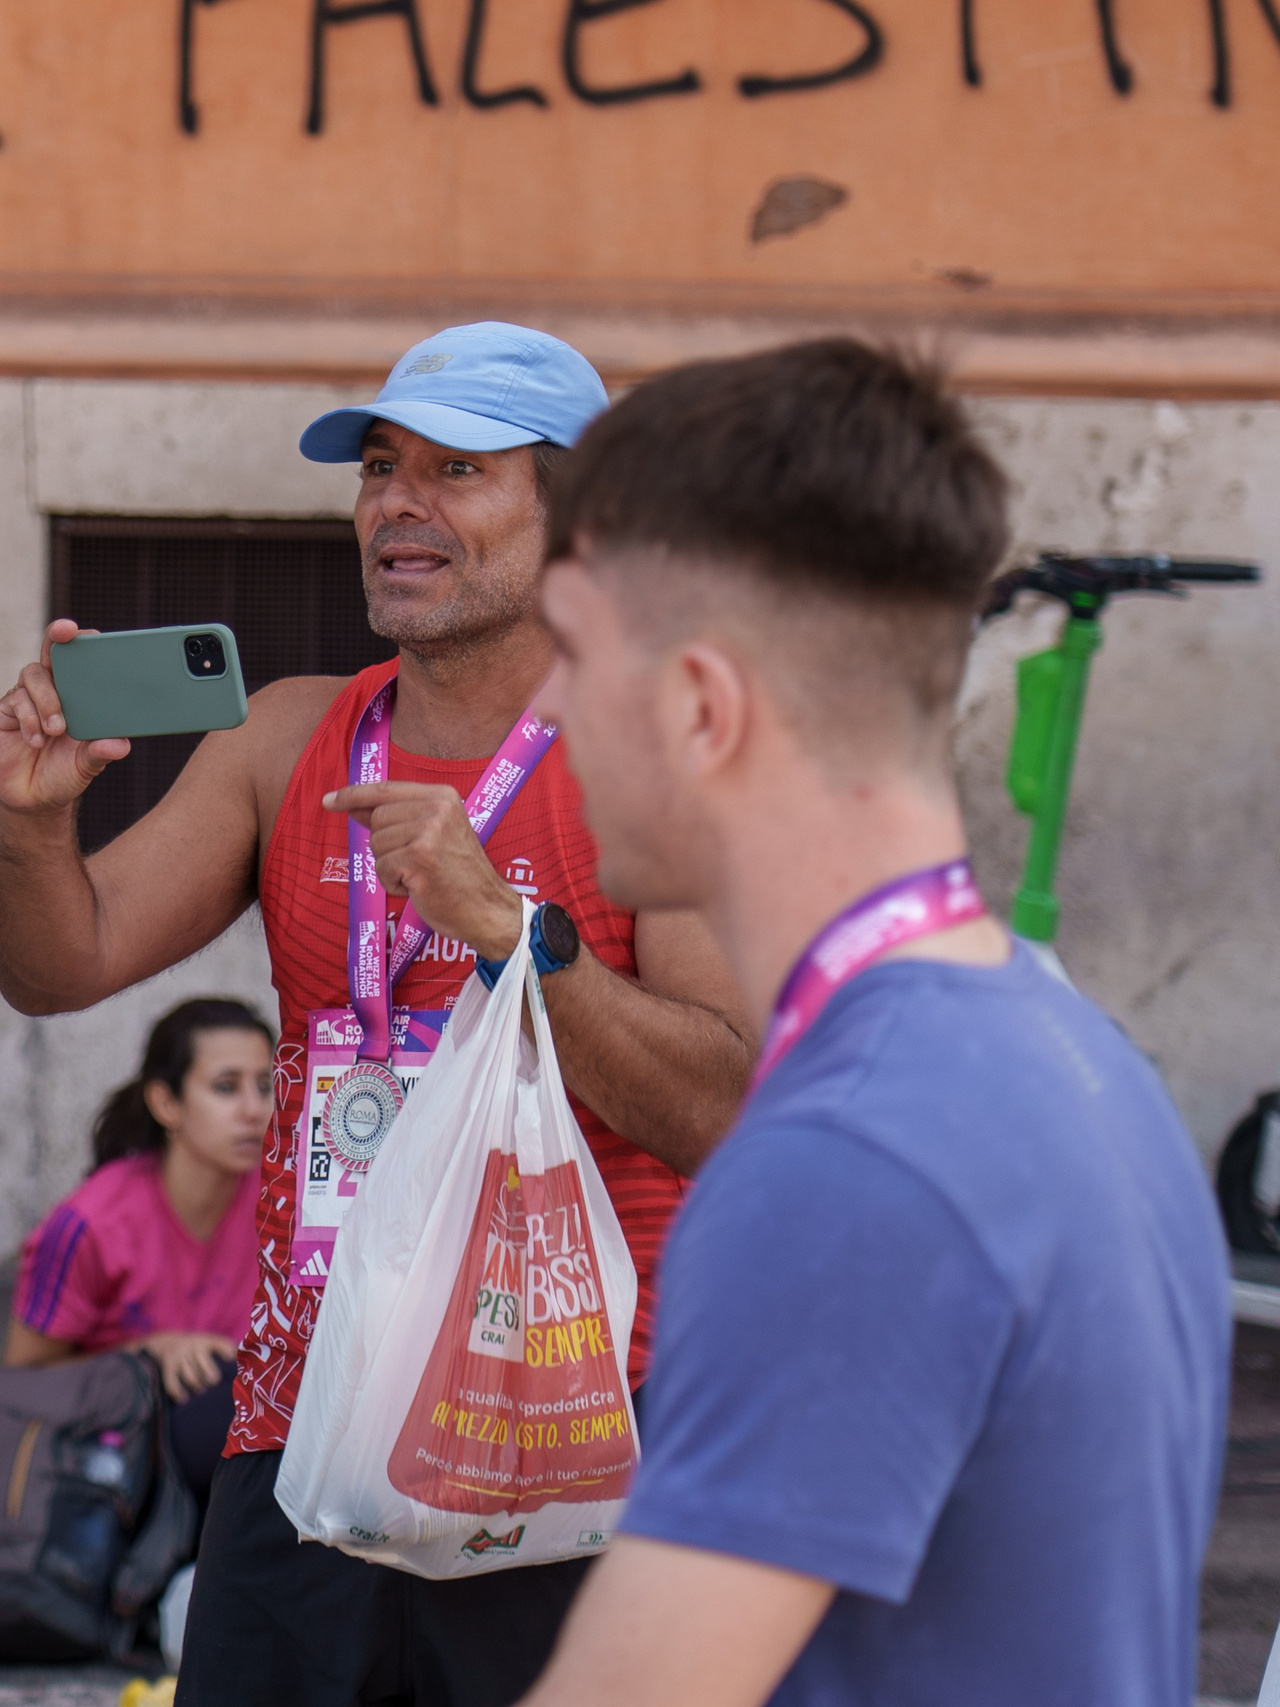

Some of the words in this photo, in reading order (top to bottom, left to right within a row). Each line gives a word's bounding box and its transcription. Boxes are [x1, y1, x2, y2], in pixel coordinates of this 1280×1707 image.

[481, 772, 499, 795] WIZZ
[495, 758, 508, 774] AIR
[481, 784, 500, 808] ROME
[497, 761, 514, 785] HALF
[487, 765, 522, 813] MARATHON
[353, 852, 363, 882] 2025
[365, 946, 373, 971] ROME
[373, 956, 381, 979] WIZZ
[358, 946, 367, 999] MARATHON
[365, 973, 373, 998] HALF
[393, 1015, 410, 1025] AIR
[349, 1108, 377, 1121] ROMA
[481, 1331, 505, 1345] CRAI
[590, 1390, 615, 1408] Cra
[455, 1463, 512, 1485] abbiamo
[557, 1468, 580, 1481] tuo
